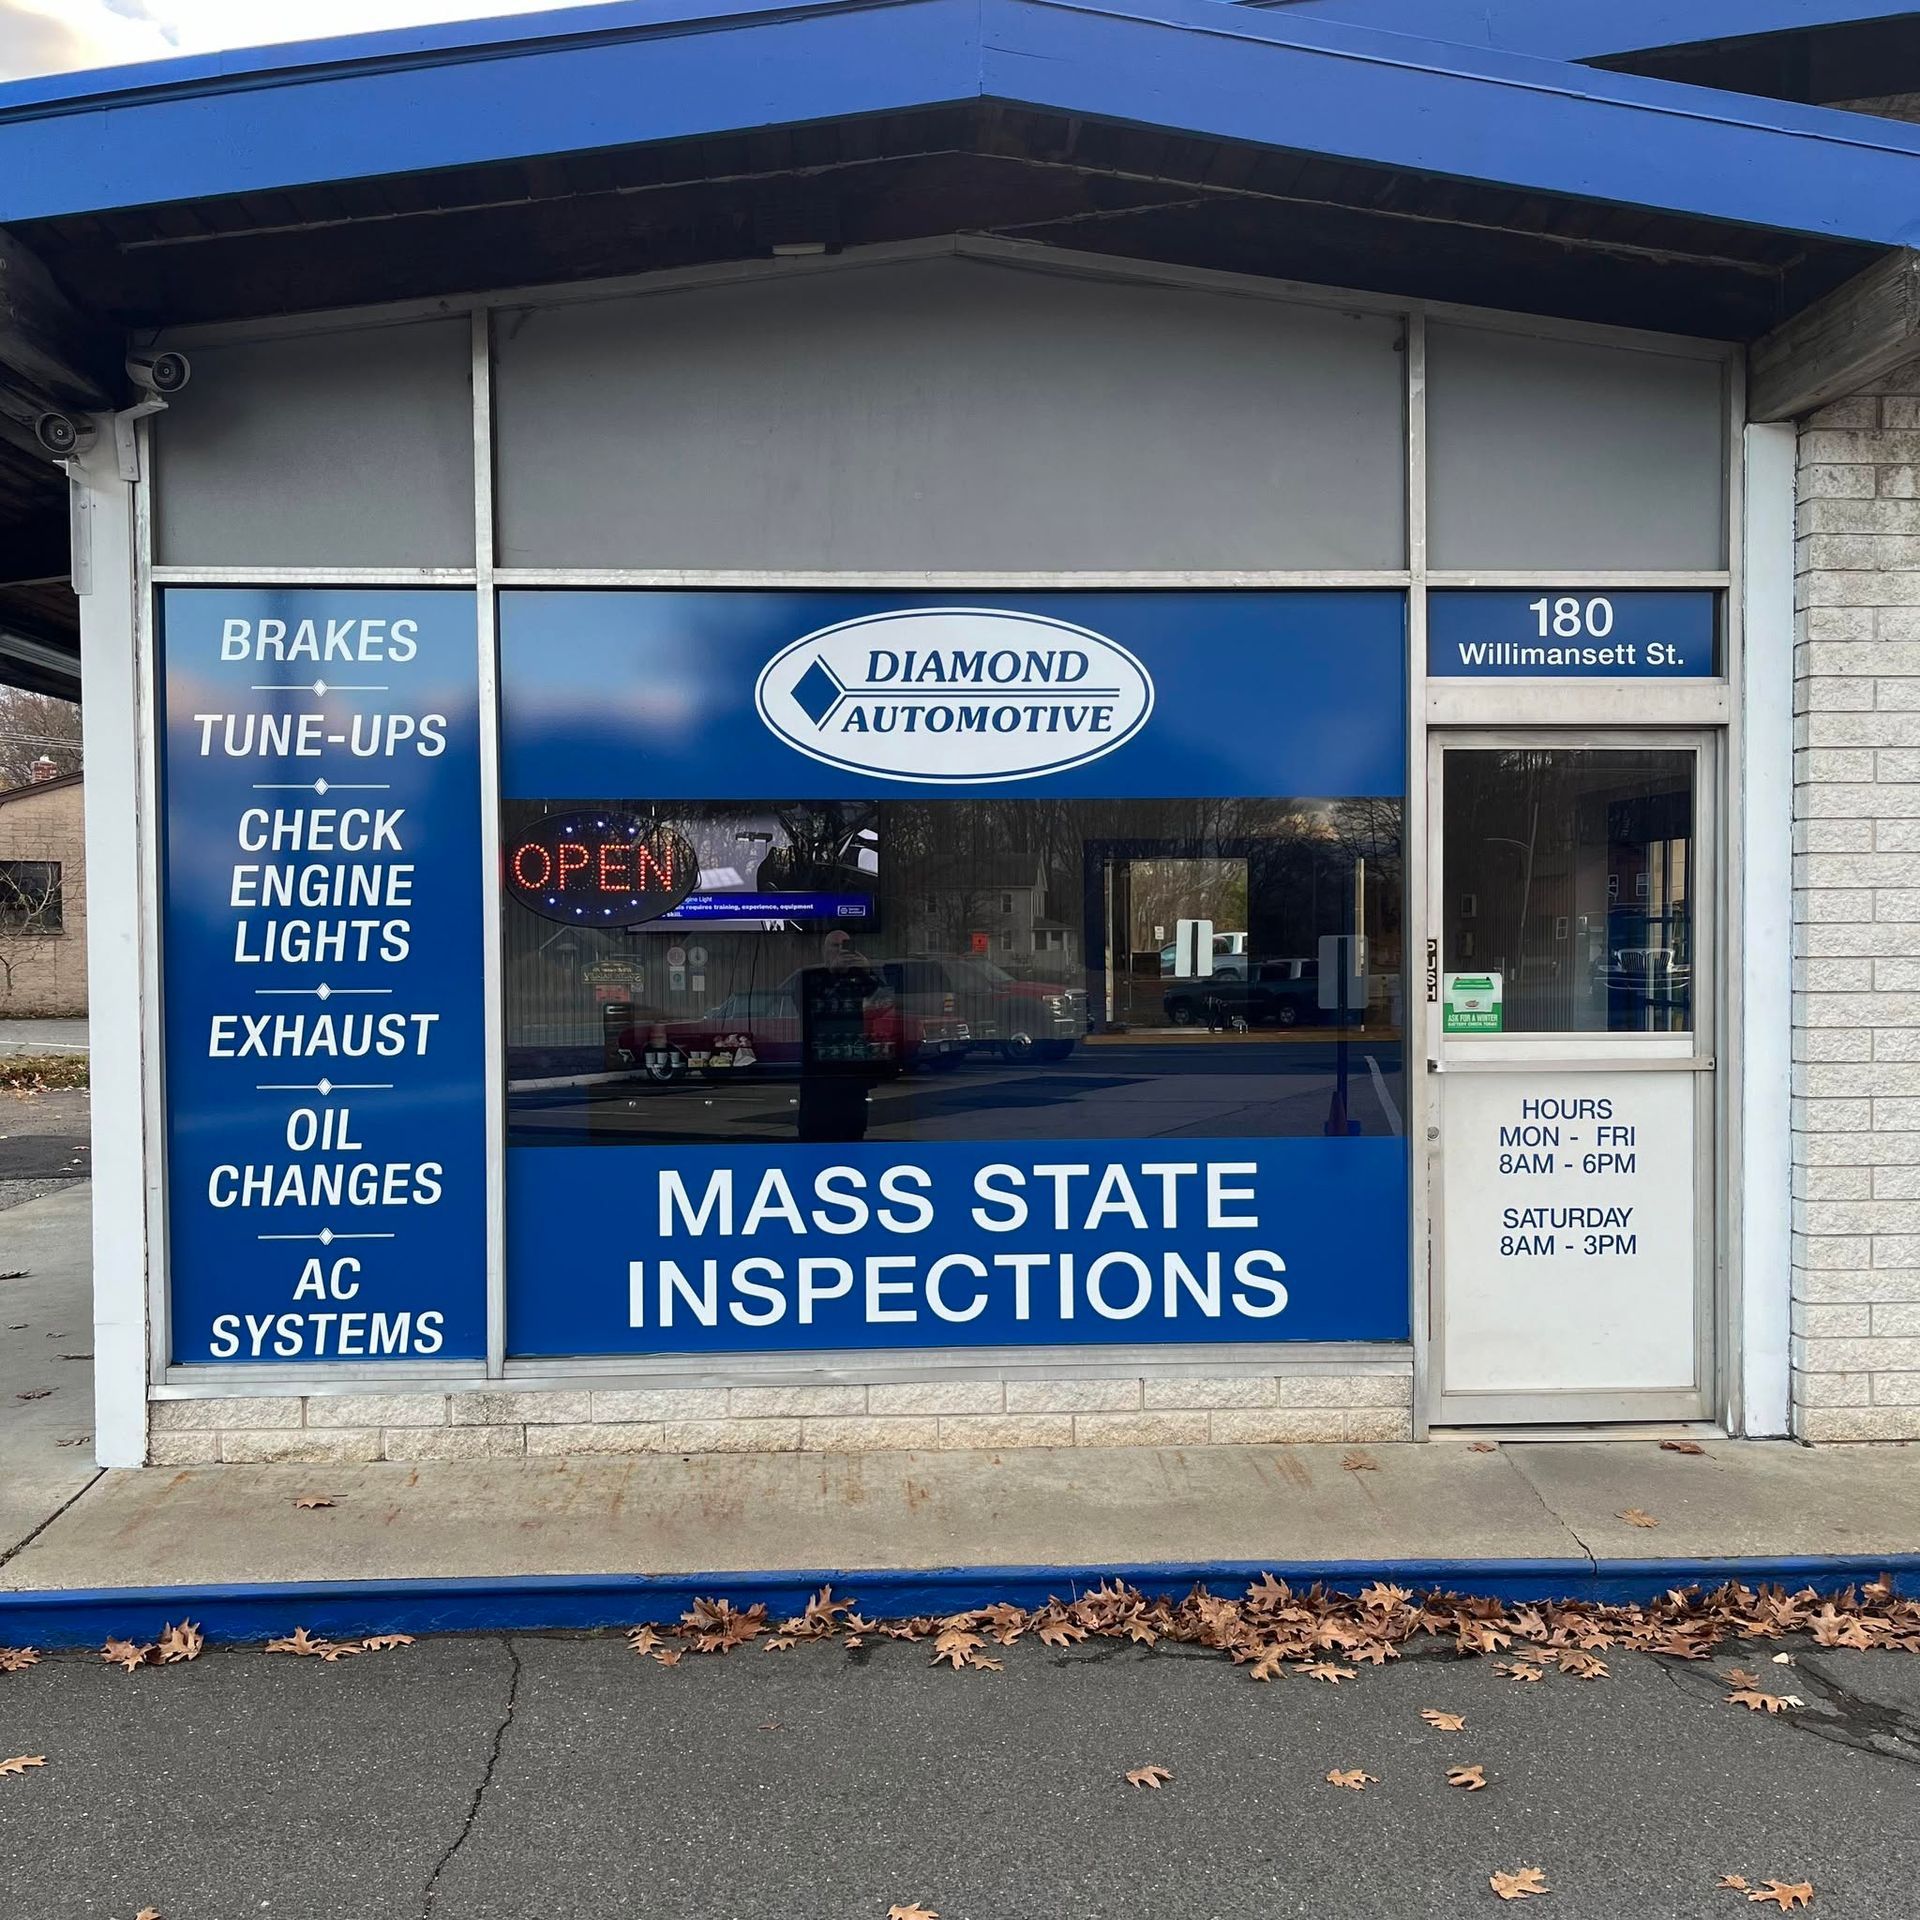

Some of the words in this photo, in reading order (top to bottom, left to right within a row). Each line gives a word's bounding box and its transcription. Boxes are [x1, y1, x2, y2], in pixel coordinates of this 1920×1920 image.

[1529, 597, 1613, 637] 180
[220, 619, 418, 662] BRAKES
[1458, 642, 1636, 665] Willimansett
[1646, 642, 1684, 665] St.
[865, 650, 1089, 683] DIAMOND
[193, 713, 447, 757] TUNE-UPS
[841, 706, 1113, 733] AUTOMOTIVE
[238, 808, 405, 852] CHECK
[230, 864, 414, 907] ENGINE
[514, 843, 673, 891] OPEN
[234, 919, 410, 963] LIGHTS
[209, 1013, 439, 1057] EXHAUST
[1472, 1013, 1477, 1021] A
[287, 1108, 362, 1151] OIL
[1522, 1098, 1613, 1120] HOURS
[1500, 1126, 1559, 1147] MON
[1597, 1126, 1636, 1147] FRI
[1499, 1153, 1554, 1174] 8AM
[1582, 1153, 1636, 1174] 6PM
[208, 1163, 443, 1208] CHANGES
[659, 1165, 935, 1237] MASS
[971, 1162, 1259, 1232] STATE
[1503, 1207, 1634, 1229] SATURDAY
[1500, 1235, 1555, 1256] 8AM
[1583, 1234, 1637, 1256] 3PM
[292, 1257, 361, 1300] AC
[629, 1249, 1289, 1328] INSPECTIONS
[210, 1311, 444, 1357] SYSTEMS
